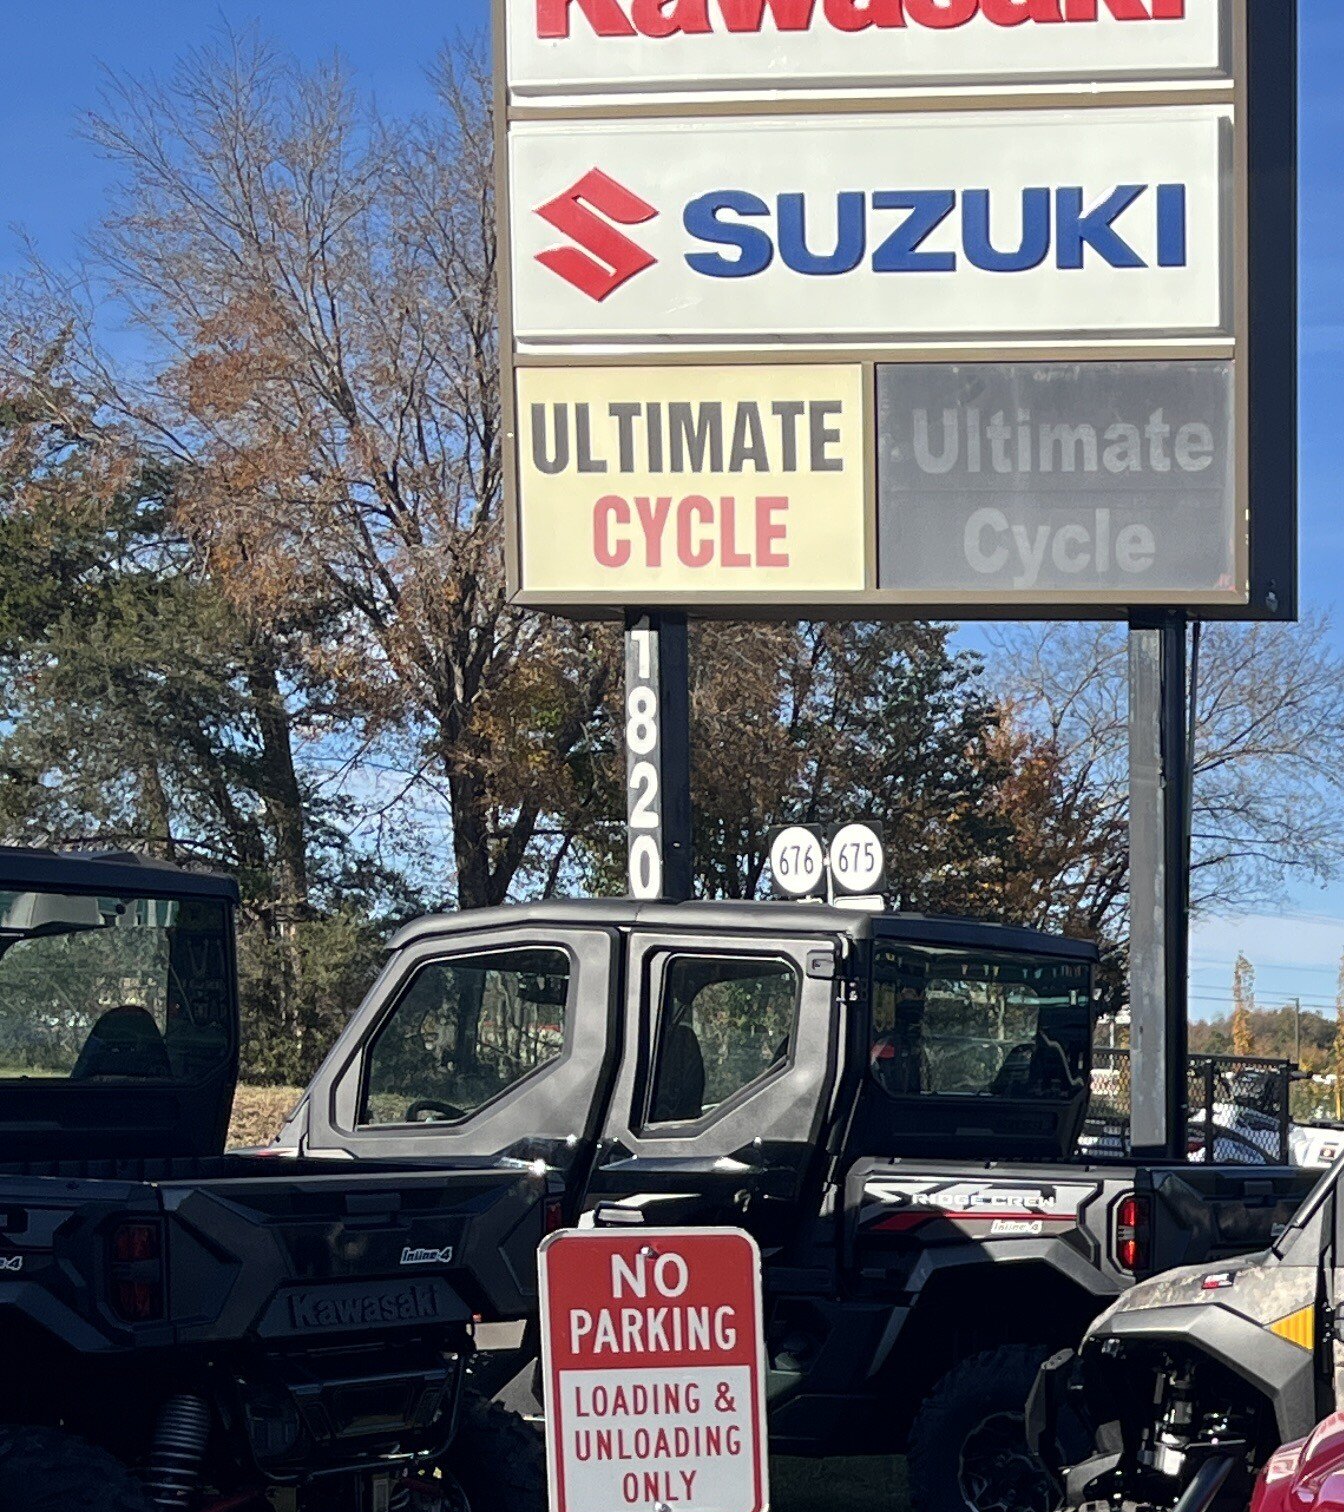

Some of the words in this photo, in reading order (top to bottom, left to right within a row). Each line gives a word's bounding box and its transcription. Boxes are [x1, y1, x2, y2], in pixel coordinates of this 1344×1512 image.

[682, 184, 1187, 280] SUZUKI
[531, 400, 844, 474] ULTIMATE
[911, 407, 1214, 473] Ultimate
[592, 495, 790, 568] CYCLE
[964, 507, 1155, 588] Cycle
[625, 614, 662, 900] 1820
[779, 845, 815, 876] 676
[838, 842, 875, 874] 675
[991, 1195, 1055, 1208] CREW
[611, 1253, 690, 1299] NO
[286, 1284, 438, 1329] Kawasaki
[569, 1306, 737, 1355] PARKING
[575, 1382, 700, 1418] LOADING
[714, 1381, 737, 1413] &
[574, 1425, 741, 1462] UNLOADING
[622, 1469, 698, 1503] ONLY
